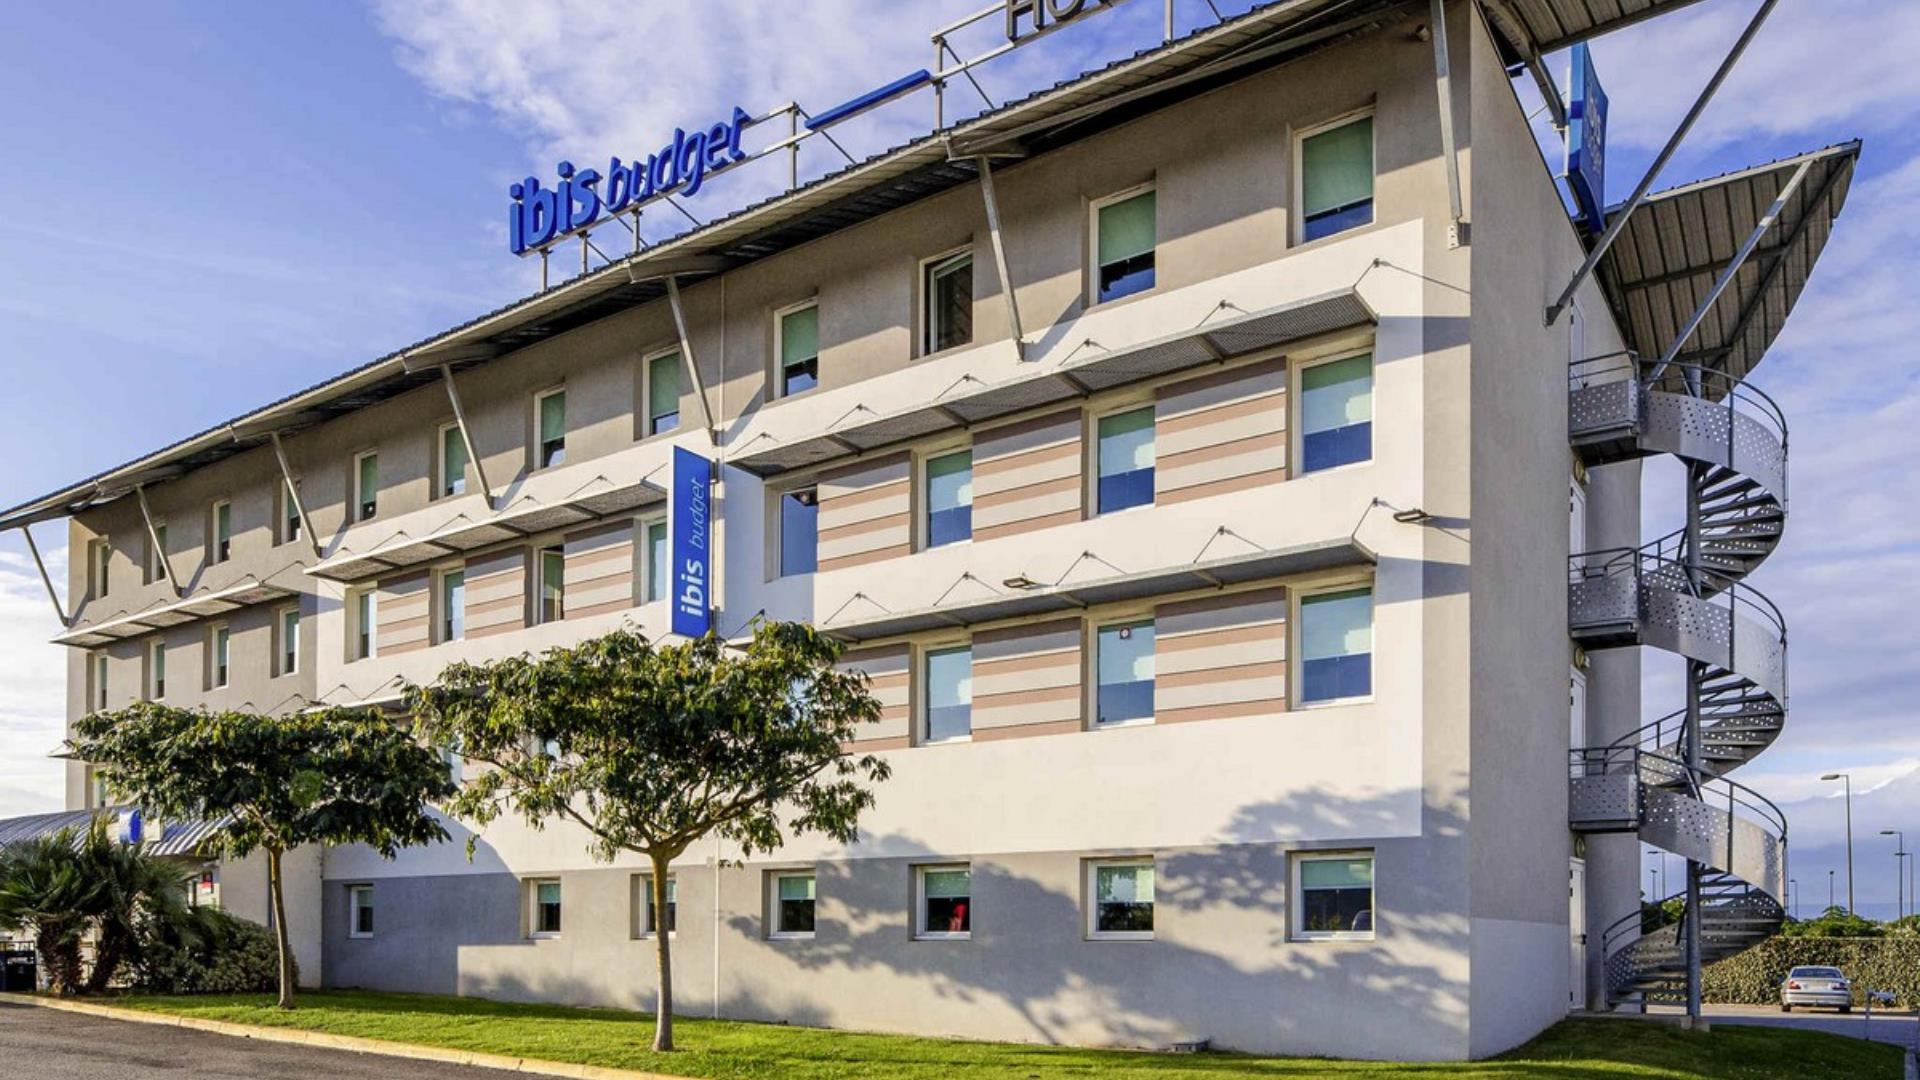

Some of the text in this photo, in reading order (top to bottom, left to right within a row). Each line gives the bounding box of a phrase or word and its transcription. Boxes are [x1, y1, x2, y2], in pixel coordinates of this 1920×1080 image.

[510, 106, 752, 256] ibis budget
[680, 476, 708, 617] ibis budget
